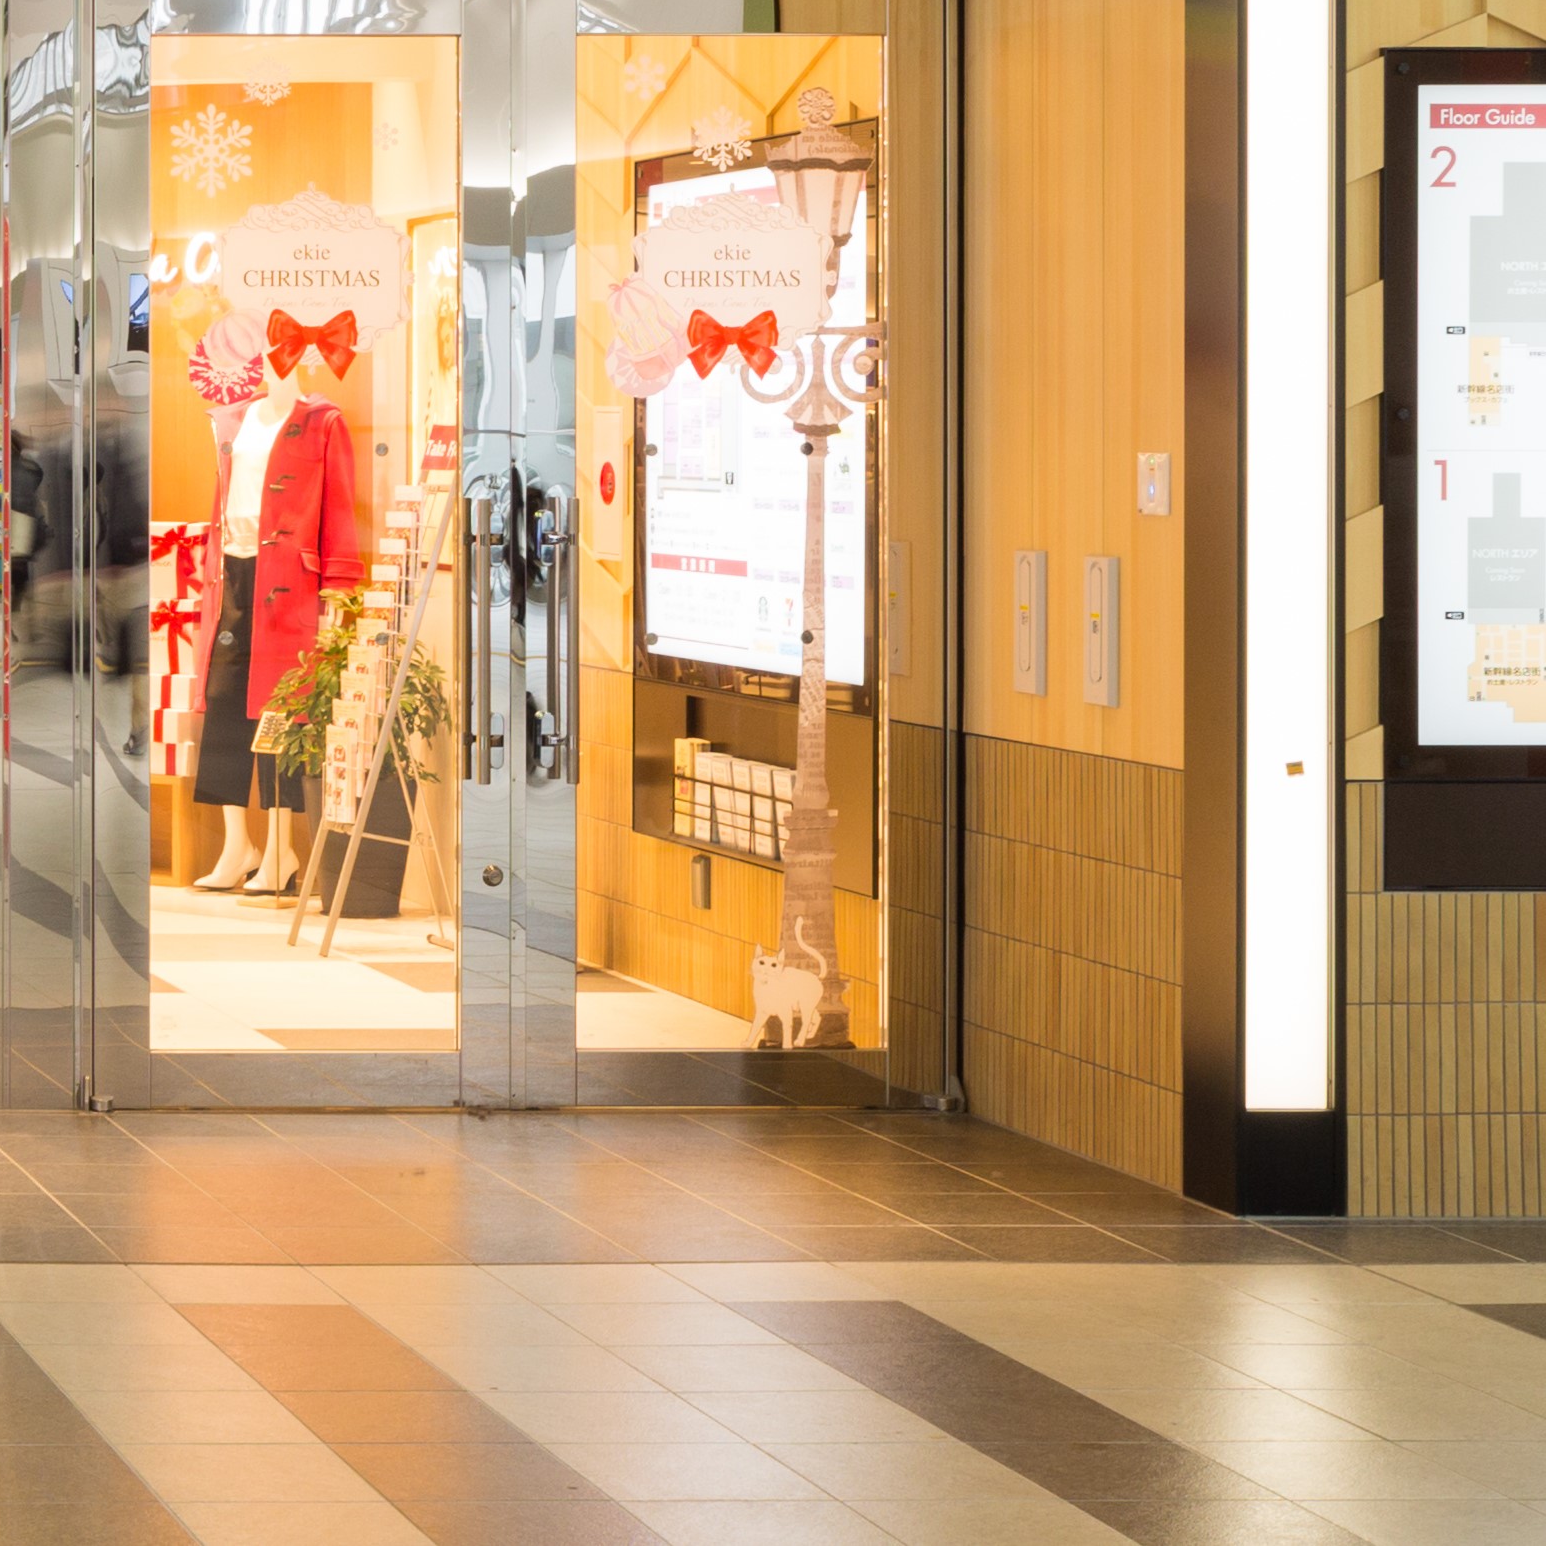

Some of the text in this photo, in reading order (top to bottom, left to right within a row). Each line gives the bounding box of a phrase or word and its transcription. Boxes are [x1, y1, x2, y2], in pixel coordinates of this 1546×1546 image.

[1440, 107, 1537, 126] Floor Guide
[1430, 146, 1457, 188] 2
[292, 243, 331, 261] ekie
[713, 243, 752, 261] ekie
[242, 269, 381, 288] CHRISTMAS
[663, 269, 802, 288] CHRISTMAS
[1434, 460, 1447, 500] 1
